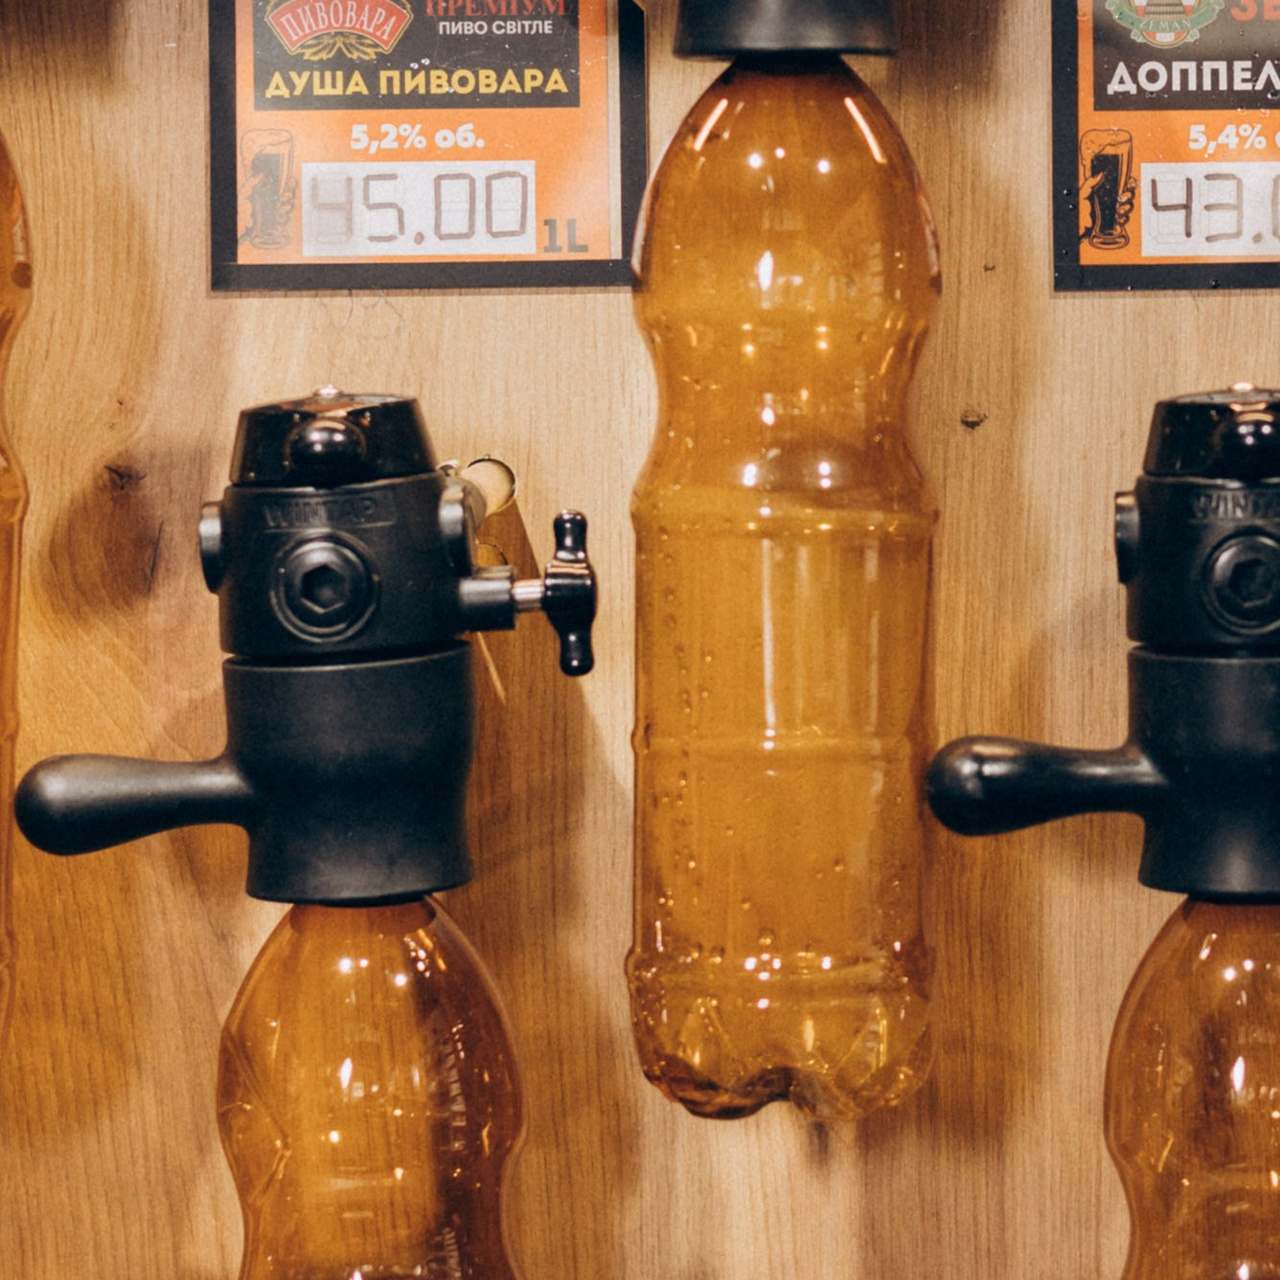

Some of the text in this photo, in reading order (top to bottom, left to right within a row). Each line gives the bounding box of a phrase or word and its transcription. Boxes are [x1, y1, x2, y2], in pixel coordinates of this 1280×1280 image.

[280, 0, 397, 40] ПИВОВАРА
[438, 19, 553, 35] ПИВО СВІТЛЕ
[265, 68, 568, 99] ДУША ПИВОВАРА
[350, 123, 427, 153] 5,2%
[1188, 123, 1267, 154] 5,4%
[311, 171, 528, 245] 45.00
[543, 218, 589, 253] 1L
